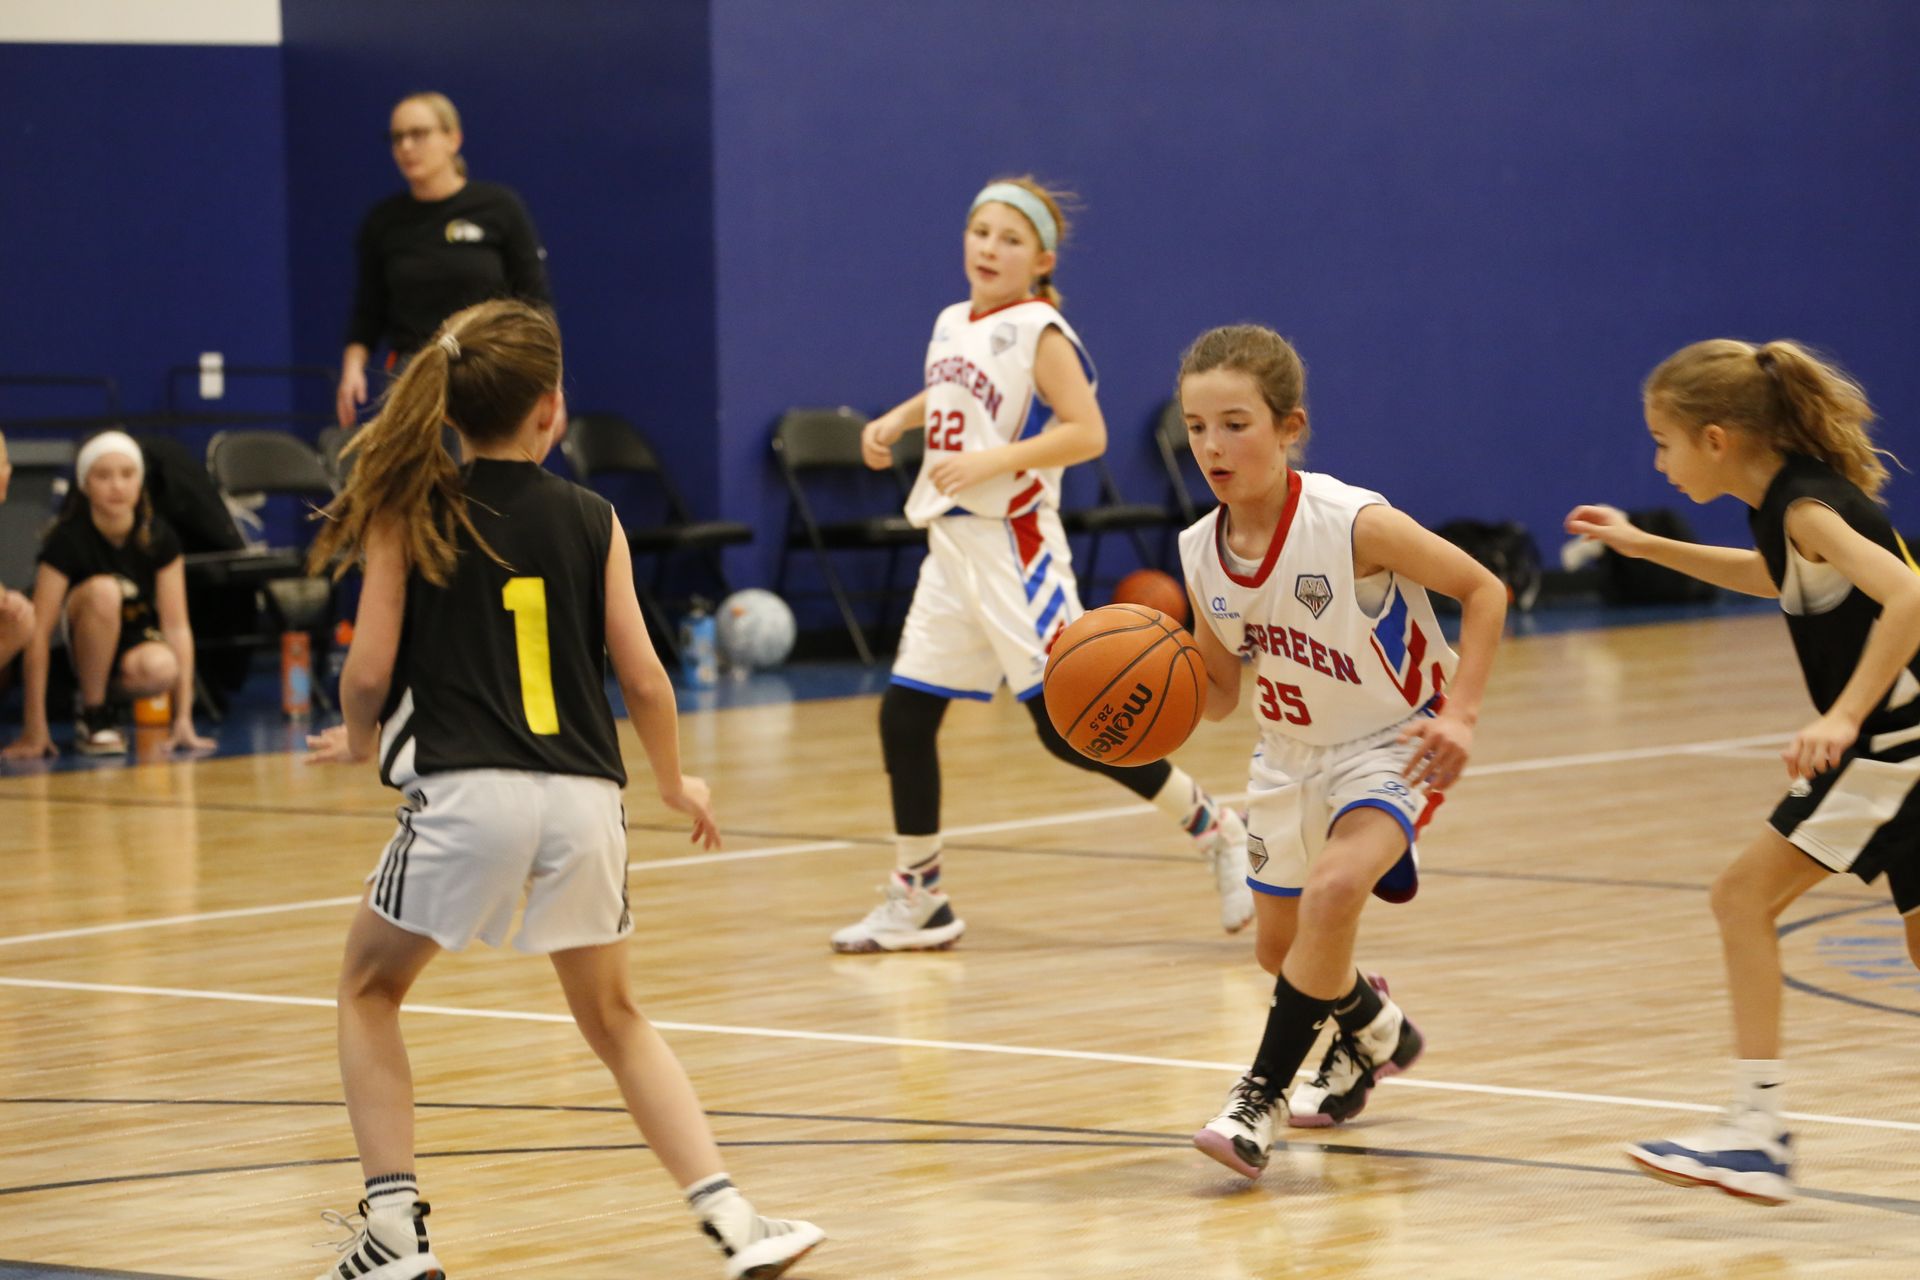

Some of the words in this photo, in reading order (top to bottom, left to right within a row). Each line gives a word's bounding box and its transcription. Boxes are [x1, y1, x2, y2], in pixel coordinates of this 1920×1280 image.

[927, 410, 965, 451] 22
[502, 576, 560, 735] 1
[1082, 682, 1153, 758] molten
[1089, 703, 1114, 731] 28.5
[1256, 674, 1312, 726] 35
